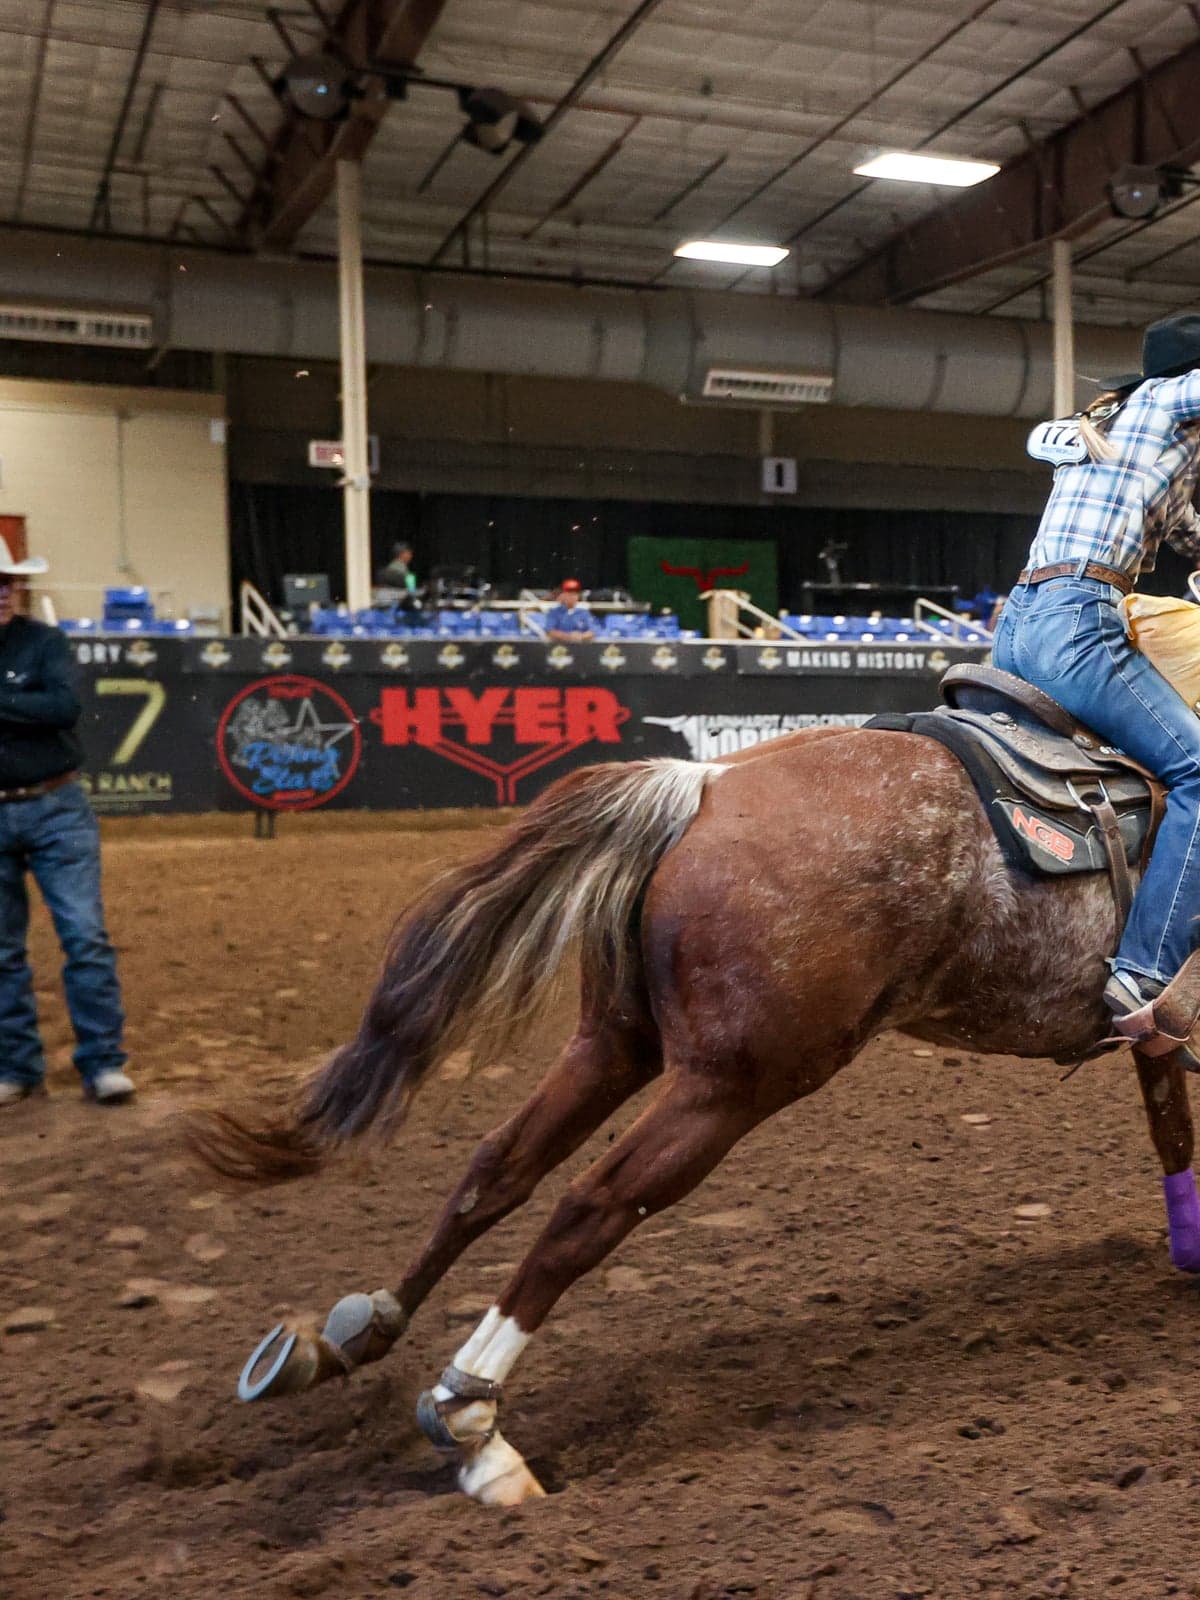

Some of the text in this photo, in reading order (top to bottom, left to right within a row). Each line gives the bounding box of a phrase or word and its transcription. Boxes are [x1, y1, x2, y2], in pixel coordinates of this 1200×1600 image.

[1041, 426, 1080, 447] 172
[786, 651, 925, 669] MAKING HISTORY
[95, 678, 166, 765] 7
[380, 687, 621, 746] HYER
[98, 772, 172, 791] RANCH
